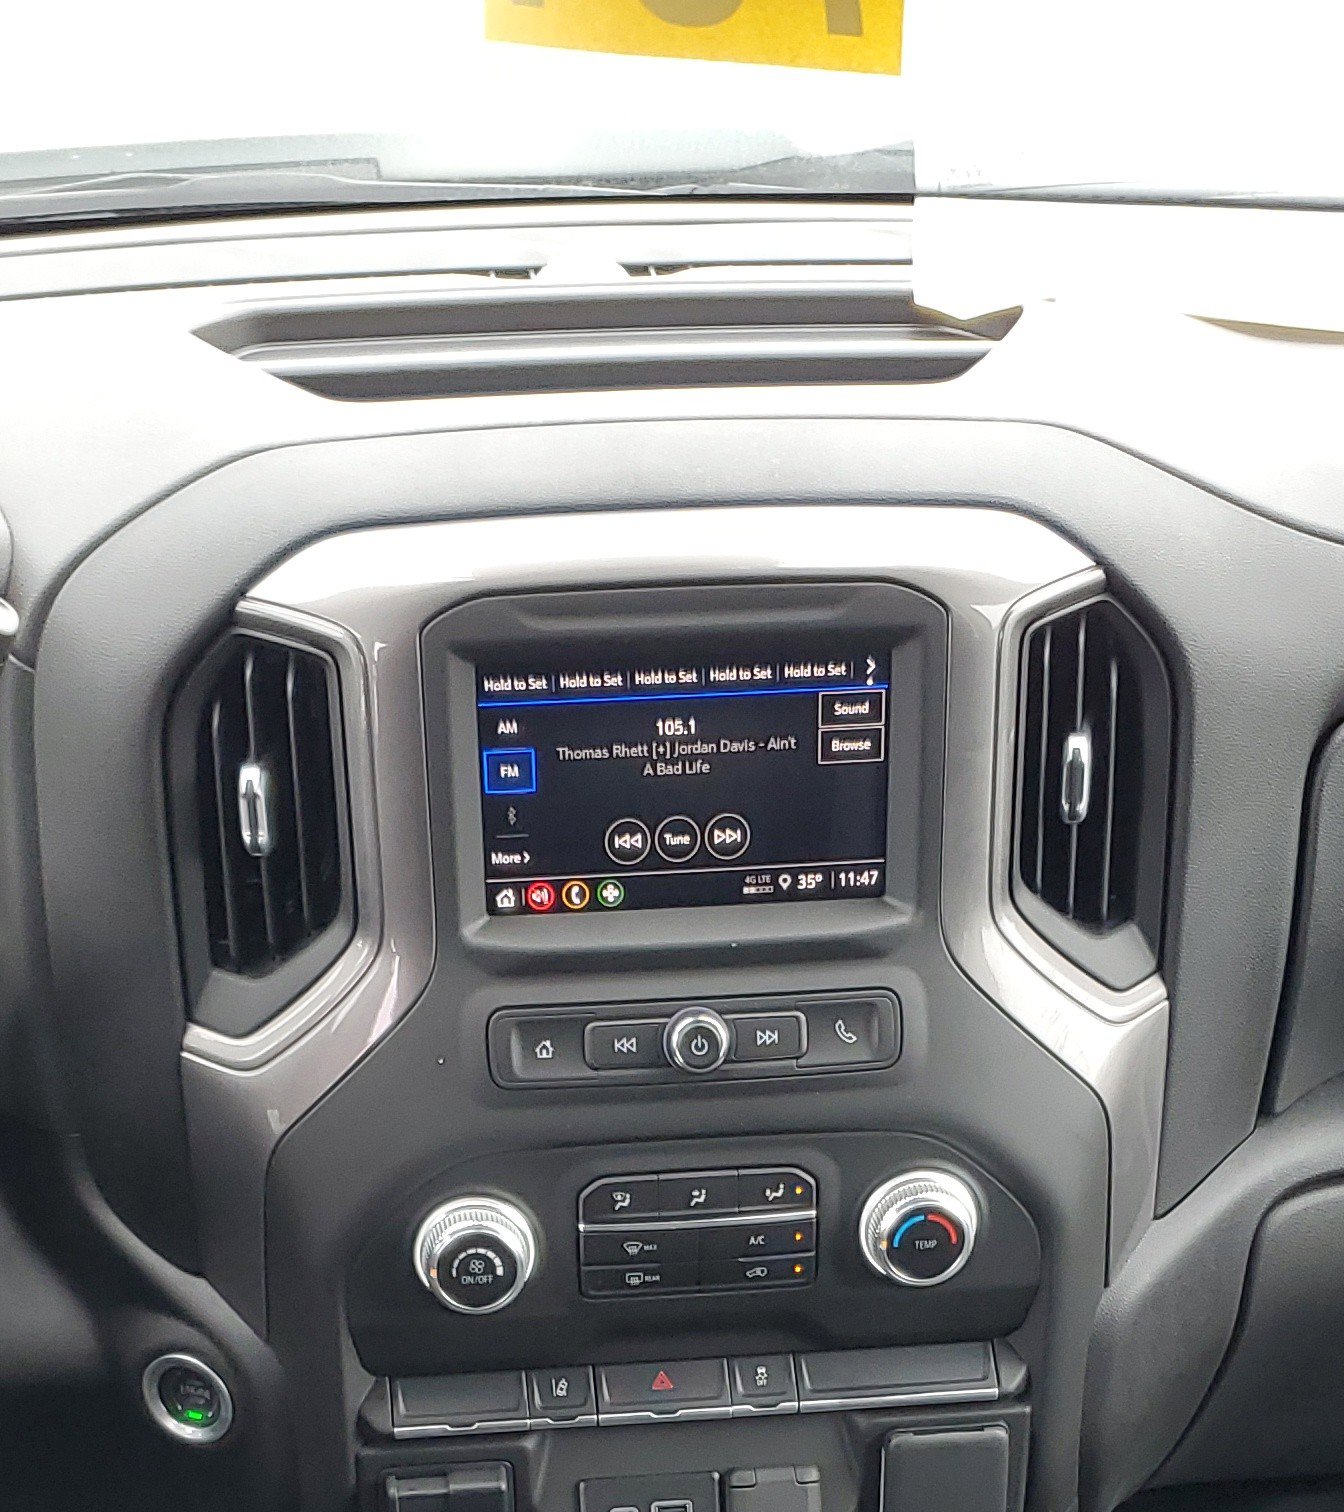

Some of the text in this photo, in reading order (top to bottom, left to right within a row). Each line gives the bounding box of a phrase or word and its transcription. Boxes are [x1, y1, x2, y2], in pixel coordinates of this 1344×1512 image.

[635, 670, 698, 685] Hold to Set
[710, 666, 772, 682] Hold to Set
[784, 663, 846, 678] Hold to Set
[484, 675, 548, 692] Hold to Set
[560, 673, 623, 688] Hold to Set
[834, 701, 870, 716] Sound
[497, 720, 518, 734] AM
[656, 718, 696, 736] 105.1
[556, 746, 610, 760] Thomas
[612, 743, 649, 758] Rhett
[652, 742, 670, 759] [+]
[672, 740, 717, 756] Jordan
[720, 739, 756, 754] Davis
[766, 736, 796, 750] Ain't
[831, 738, 872, 752] Browse
[500, 764, 519, 778] FM
[643, 760, 710, 776] A Bad Life
[664, 833, 690, 846] Tune
[491, 852, 522, 864] More
[744, 874, 771, 884] 4G LTE
[839, 869, 879, 888] 11:47
[749, 1235, 765, 1245] A/C
[914, 1240, 938, 1250] TEMP
[461, 1274, 493, 1284] ON/OFF
